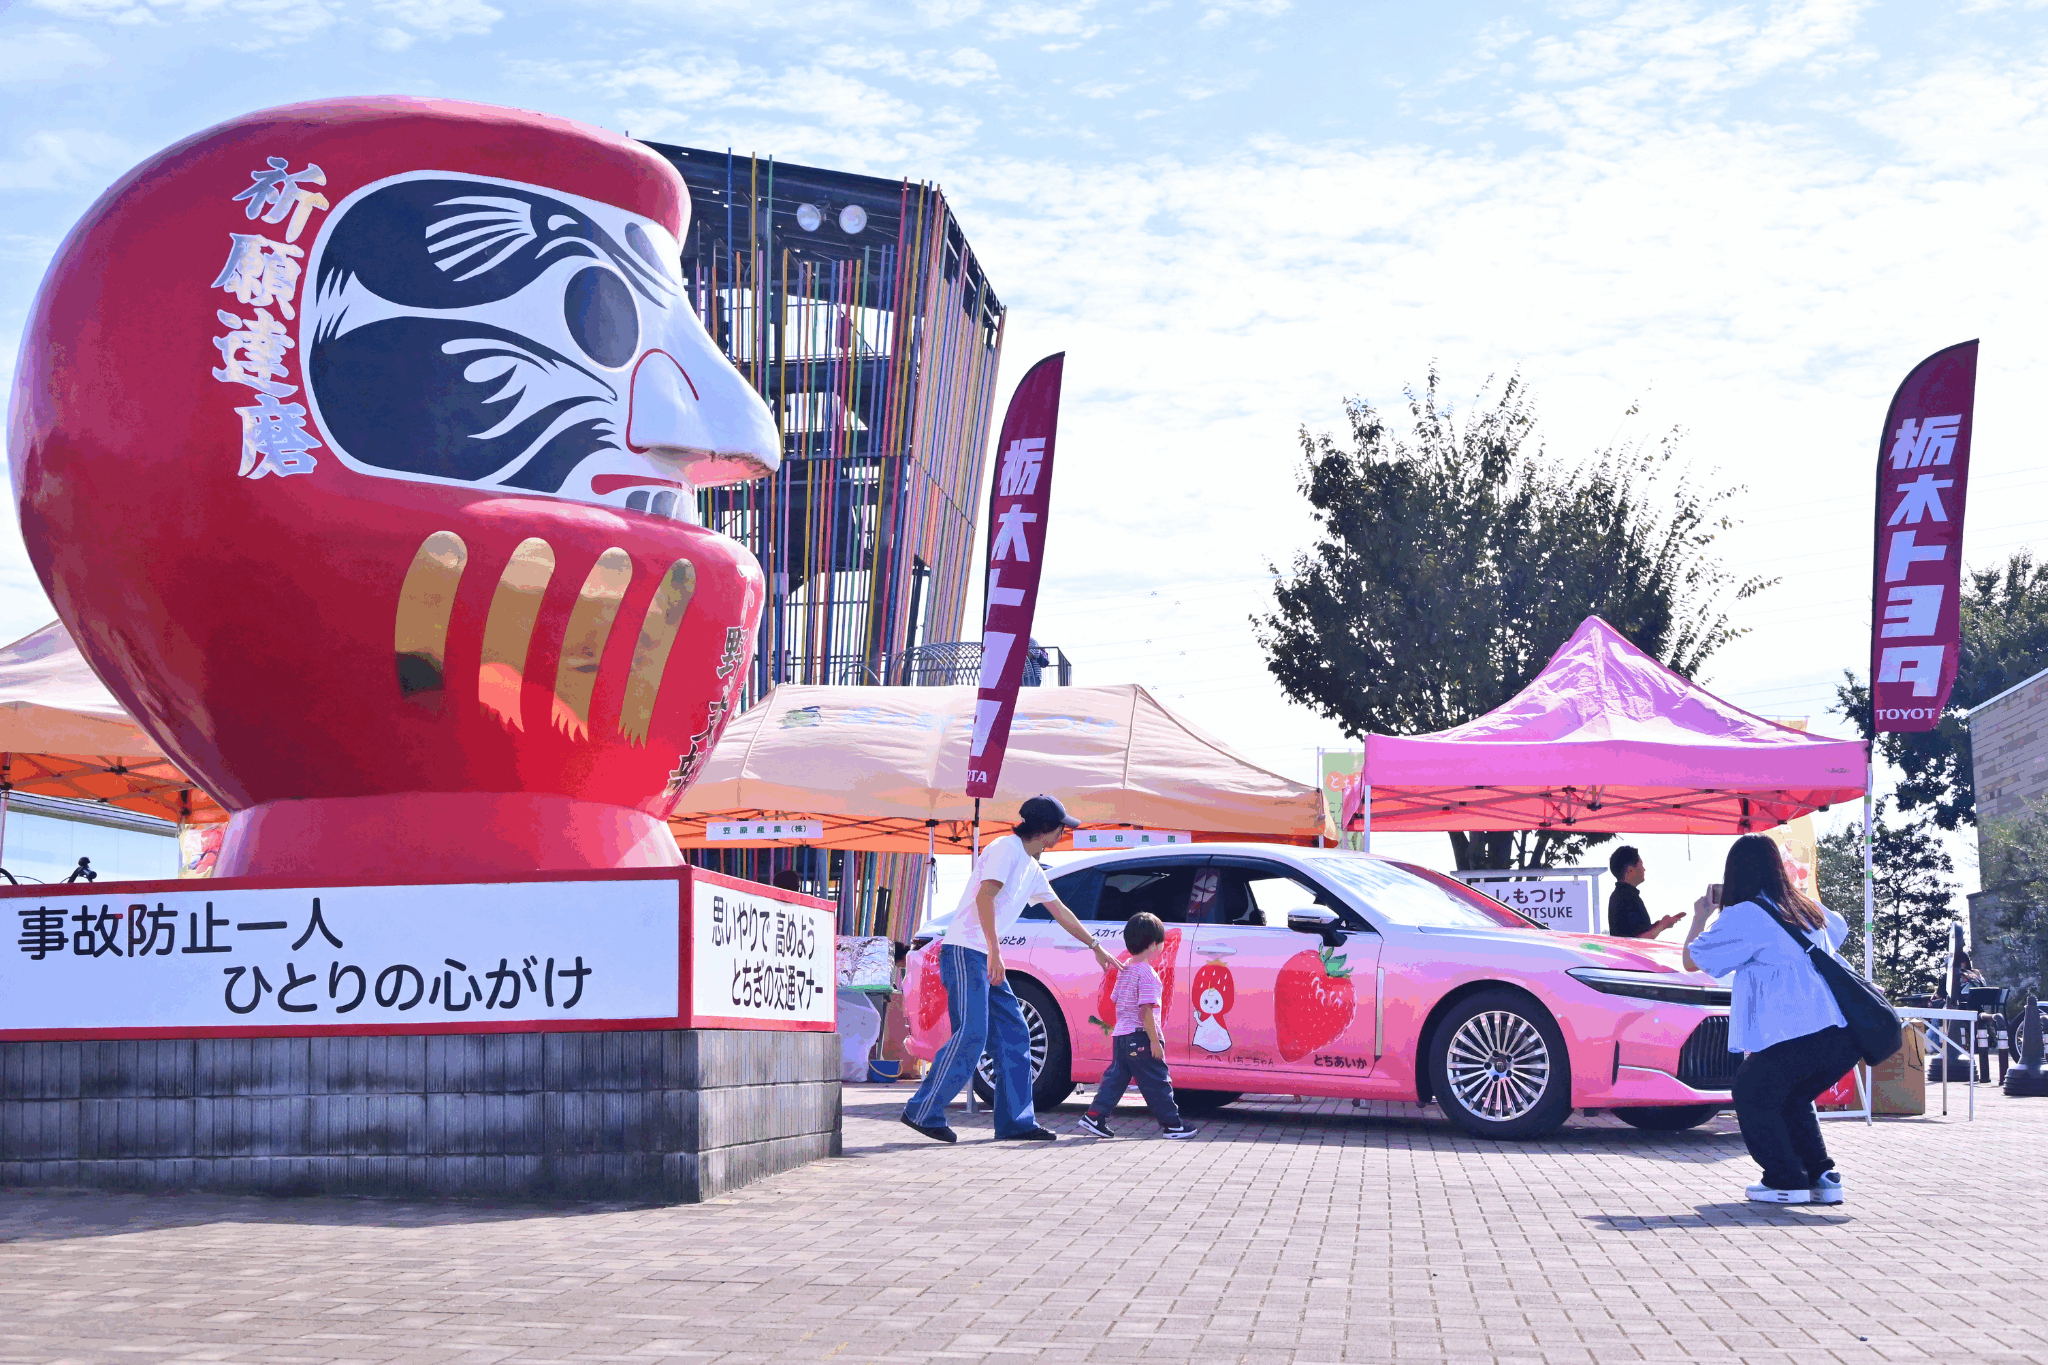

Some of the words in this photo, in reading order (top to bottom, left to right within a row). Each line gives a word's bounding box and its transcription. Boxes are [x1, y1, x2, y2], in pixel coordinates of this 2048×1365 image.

[211, 156, 330, 480] 祈願達磨
[1877, 413, 1963, 698] 栃木トヨタ
[1496, 887, 1566, 904] しもつけ
[17, 897, 343, 960] 事故防止一人
[224, 955, 593, 1014] ひとりの心がけ
[732, 958, 823, 1010] とちぎの交通マナー
[1313, 1054, 1368, 1070] とちあいか
